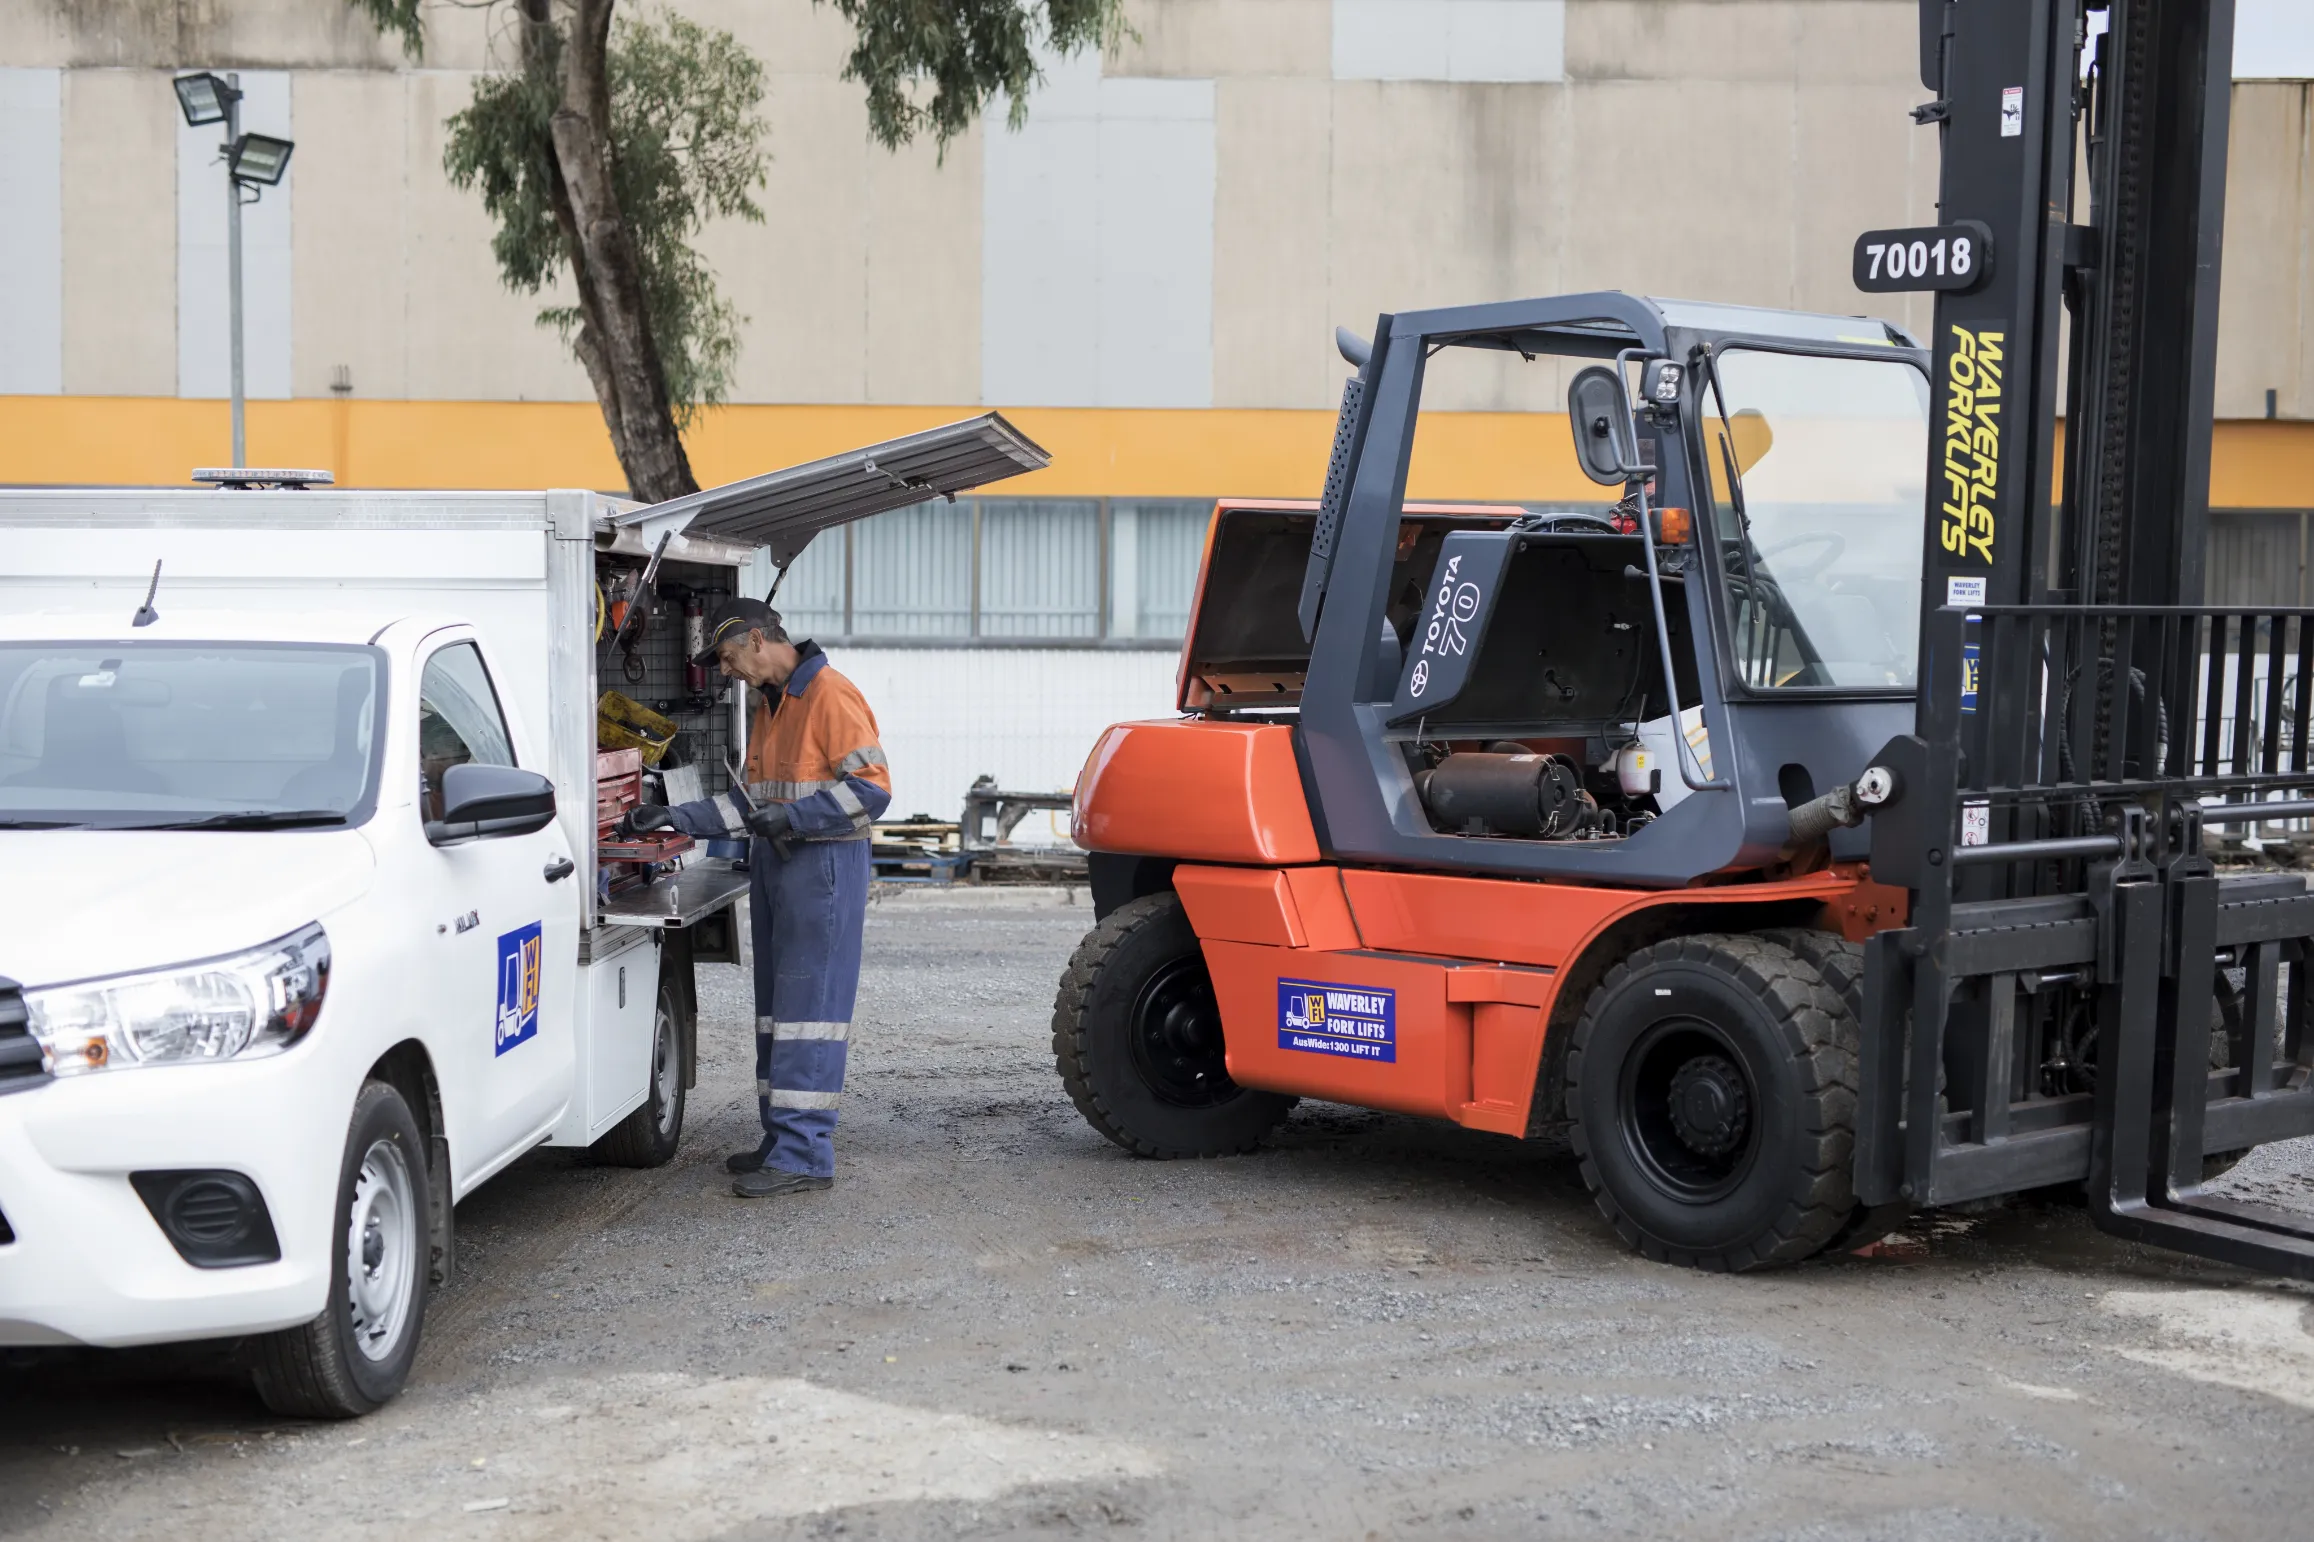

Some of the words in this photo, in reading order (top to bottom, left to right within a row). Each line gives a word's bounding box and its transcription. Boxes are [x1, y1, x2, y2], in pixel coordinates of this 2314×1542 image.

[1866, 237, 1972, 280] 70018
[1941, 324, 1977, 557] FORKLIFTS
[1967, 331, 2004, 565] WAVERLEY
[1422, 555, 1463, 655] TOYOTA
[1438, 582, 1480, 656] 70
[524, 940, 537, 973] W
[524, 970, 537, 1011] FL
[1310, 997, 1322, 1007] W
[1326, 992, 1386, 1015] WAVERLEY
[1312, 1009, 1324, 1021] FL
[1327, 1018, 1355, 1035] FORK
[1357, 1022, 1385, 1038] LIFTS
[1351, 1043, 1370, 1055] LIFT
[1371, 1046, 1381, 1056] IT
